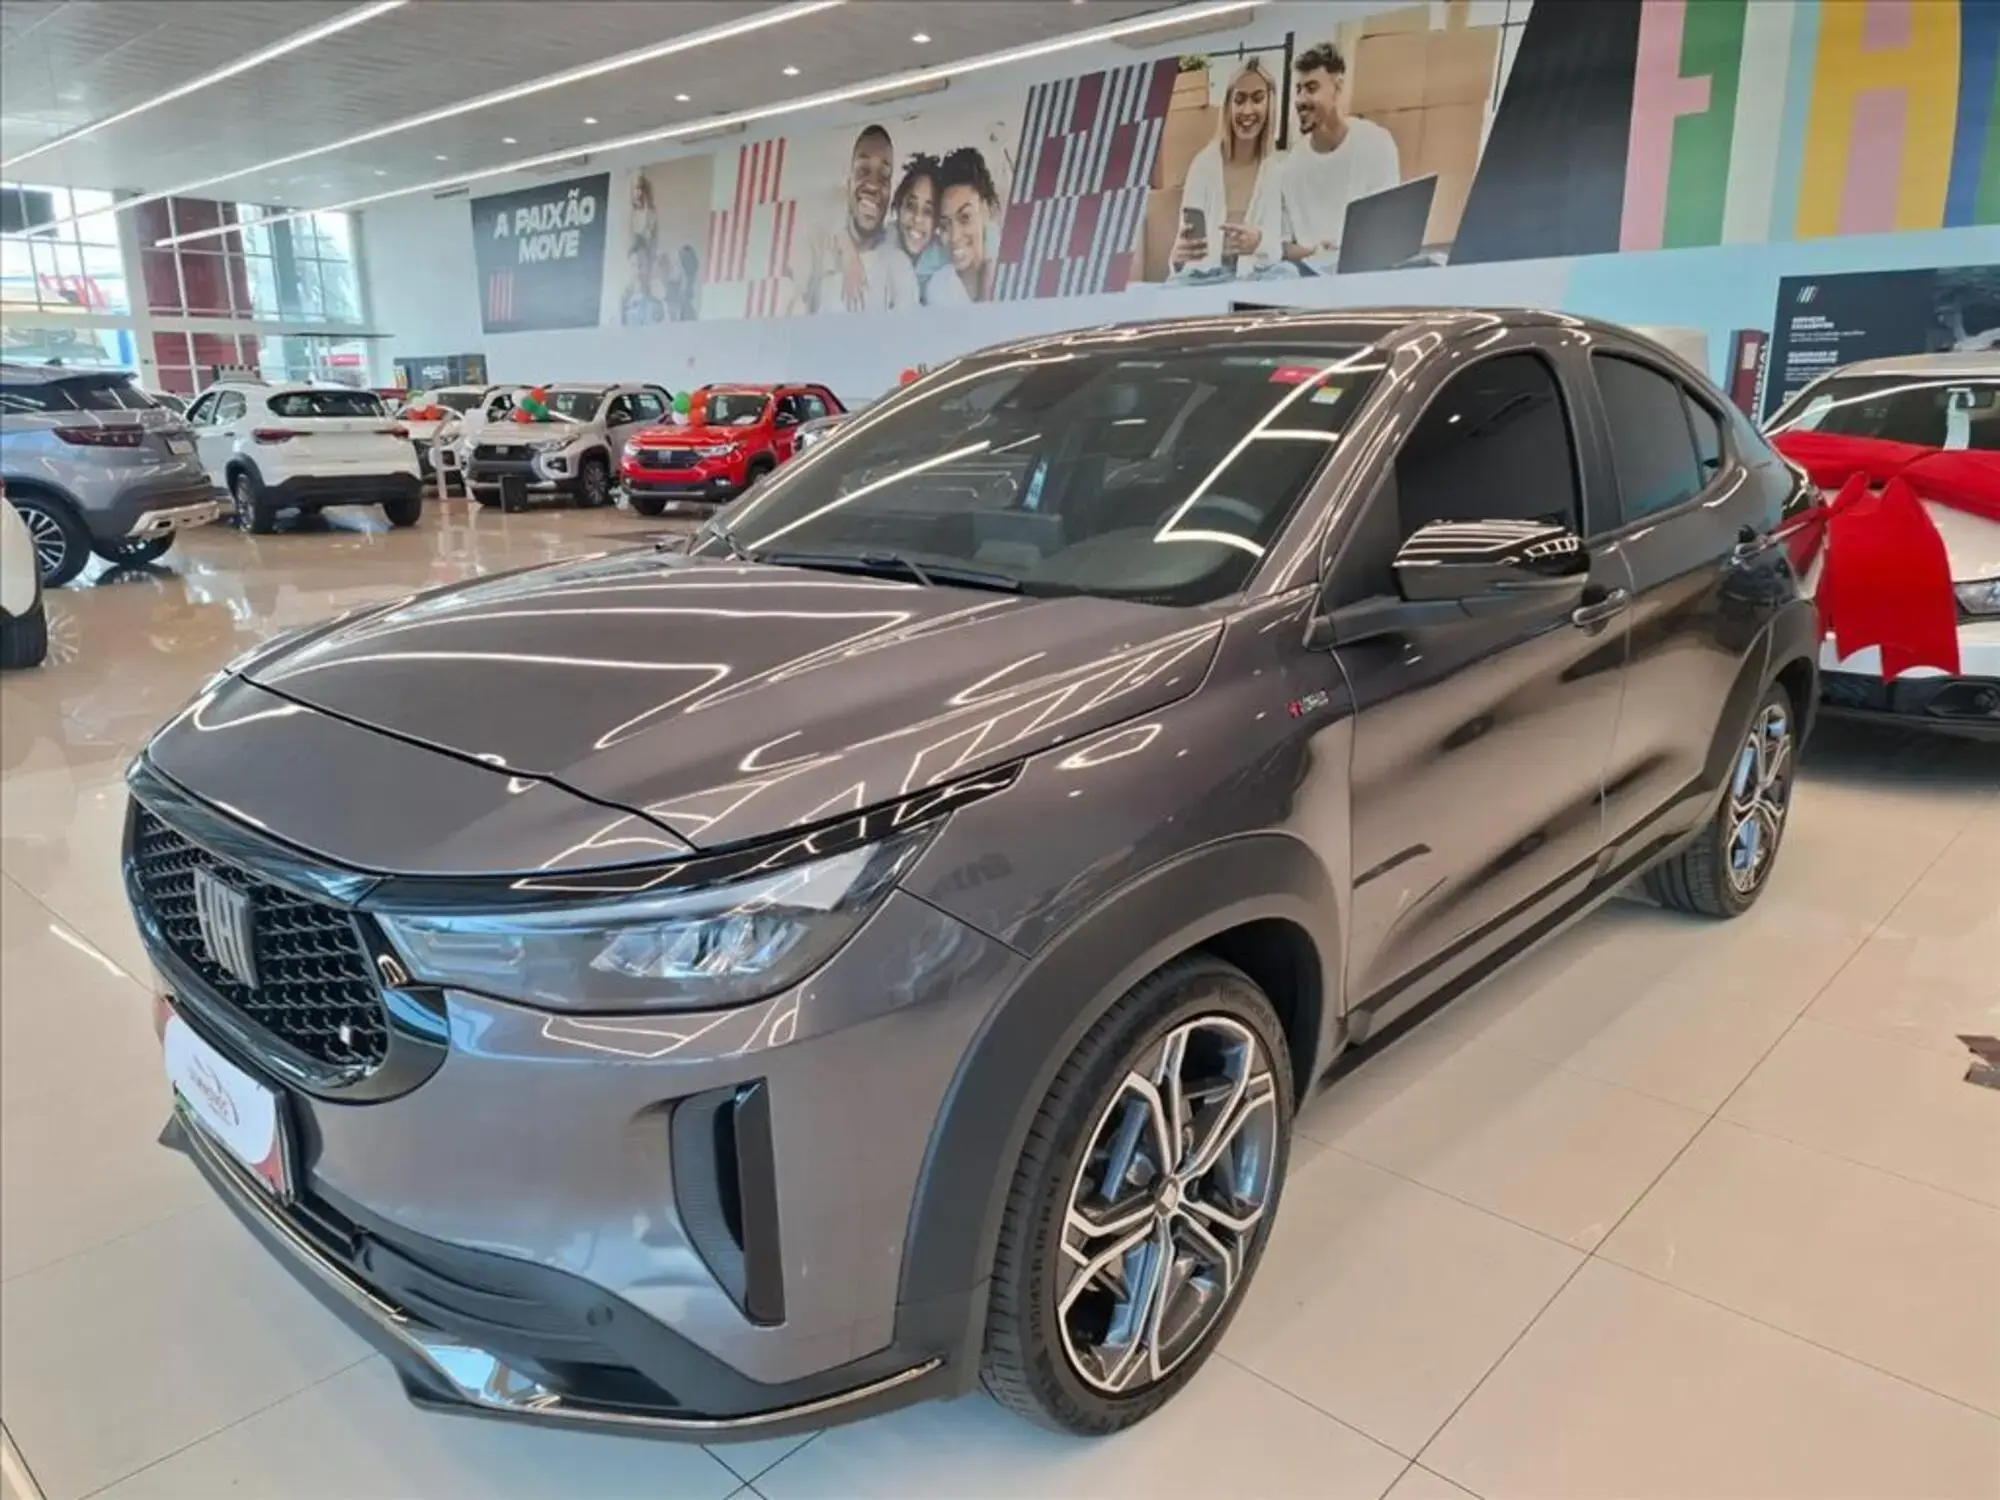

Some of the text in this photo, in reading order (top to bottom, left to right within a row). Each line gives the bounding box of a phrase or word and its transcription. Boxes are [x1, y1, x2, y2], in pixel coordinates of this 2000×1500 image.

[494, 188, 596, 239] A PAIXÃO
[519, 230, 580, 264] MOVE
[194, 867, 257, 990] FIAT
